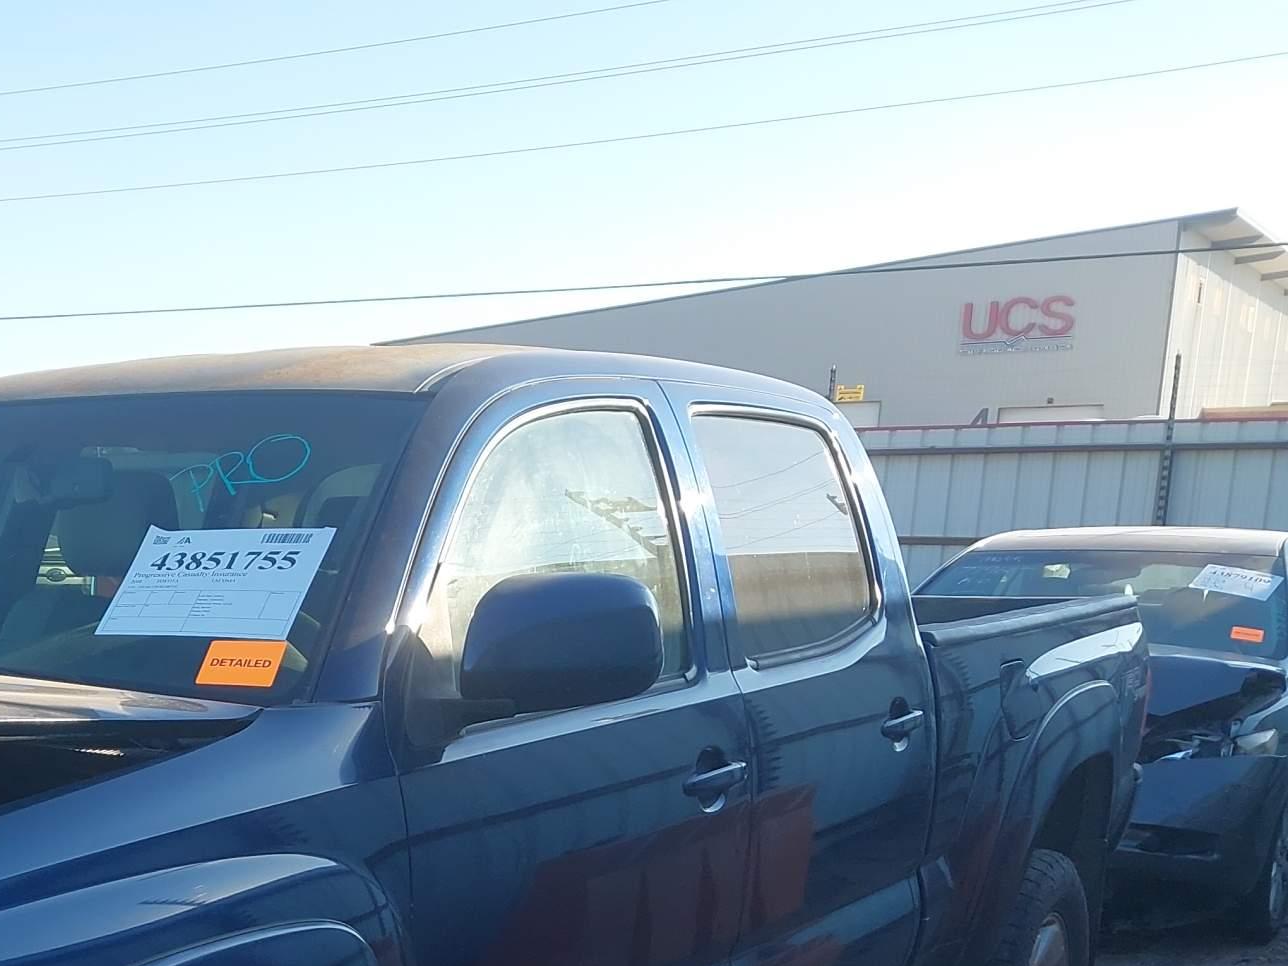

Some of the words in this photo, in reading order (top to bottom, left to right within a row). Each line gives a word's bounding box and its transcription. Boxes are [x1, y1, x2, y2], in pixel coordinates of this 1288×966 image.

[961, 295, 1076, 340] UCS
[169, 434, 311, 512] PRO
[150, 550, 301, 571] 43851755
[209, 657, 272, 668] DETAILED
